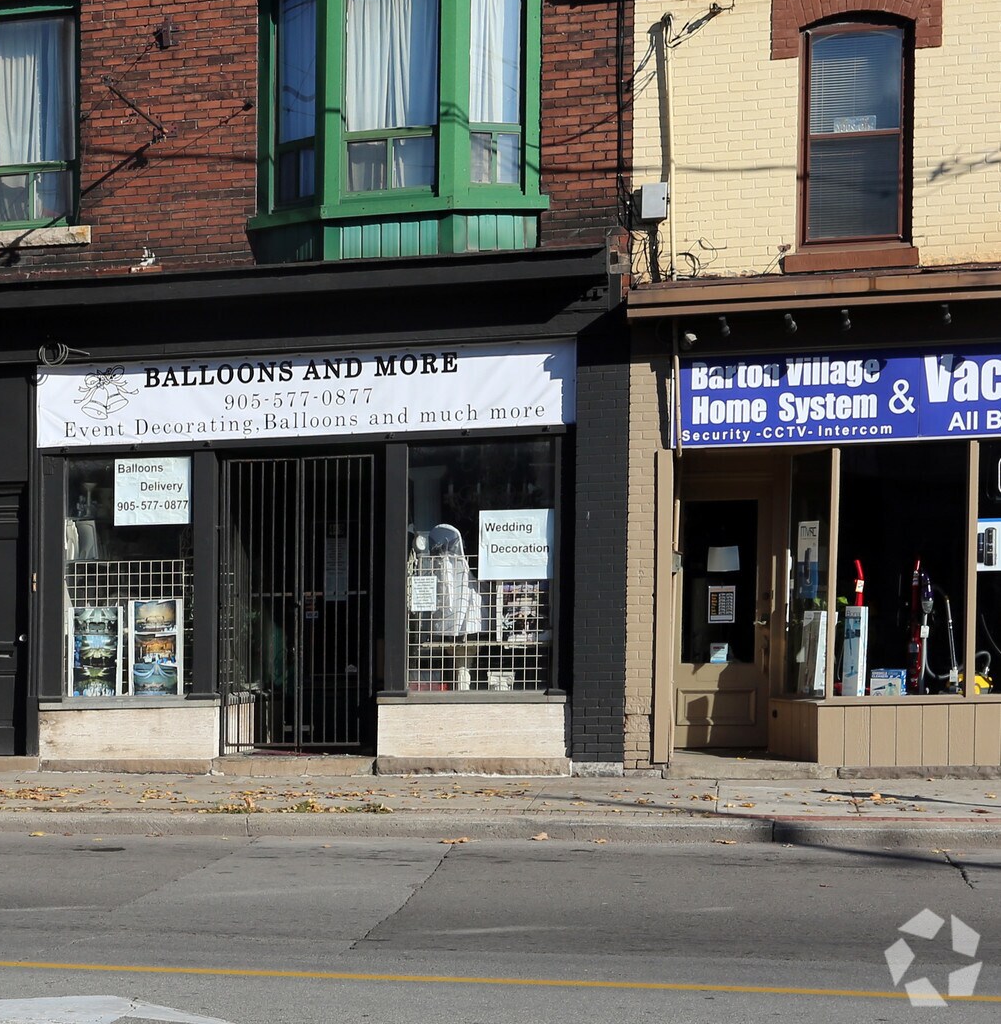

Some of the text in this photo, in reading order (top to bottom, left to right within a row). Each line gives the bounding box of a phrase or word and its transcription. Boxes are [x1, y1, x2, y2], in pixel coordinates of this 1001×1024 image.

[143, 352, 459, 388] BALLOONS AND MORE
[691, 356, 881, 391] Barton Village
[224, 387, 373, 411] 905-577-0877
[691, 379, 916, 425] Home System &
[64, 420, 125, 438] Event
[369, 407, 408, 426] and
[420, 404, 478, 423] much
[489, 404, 546, 420] more
[948, 410, 979, 431] All
[681, 428, 751, 442] Security
[818, 423, 893, 437] Intercom
[117, 463, 164, 474] Balloons
[140, 481, 184, 493] Delivery
[484, 522, 533, 534] Wedding
[490, 543, 550, 554] Decoration
